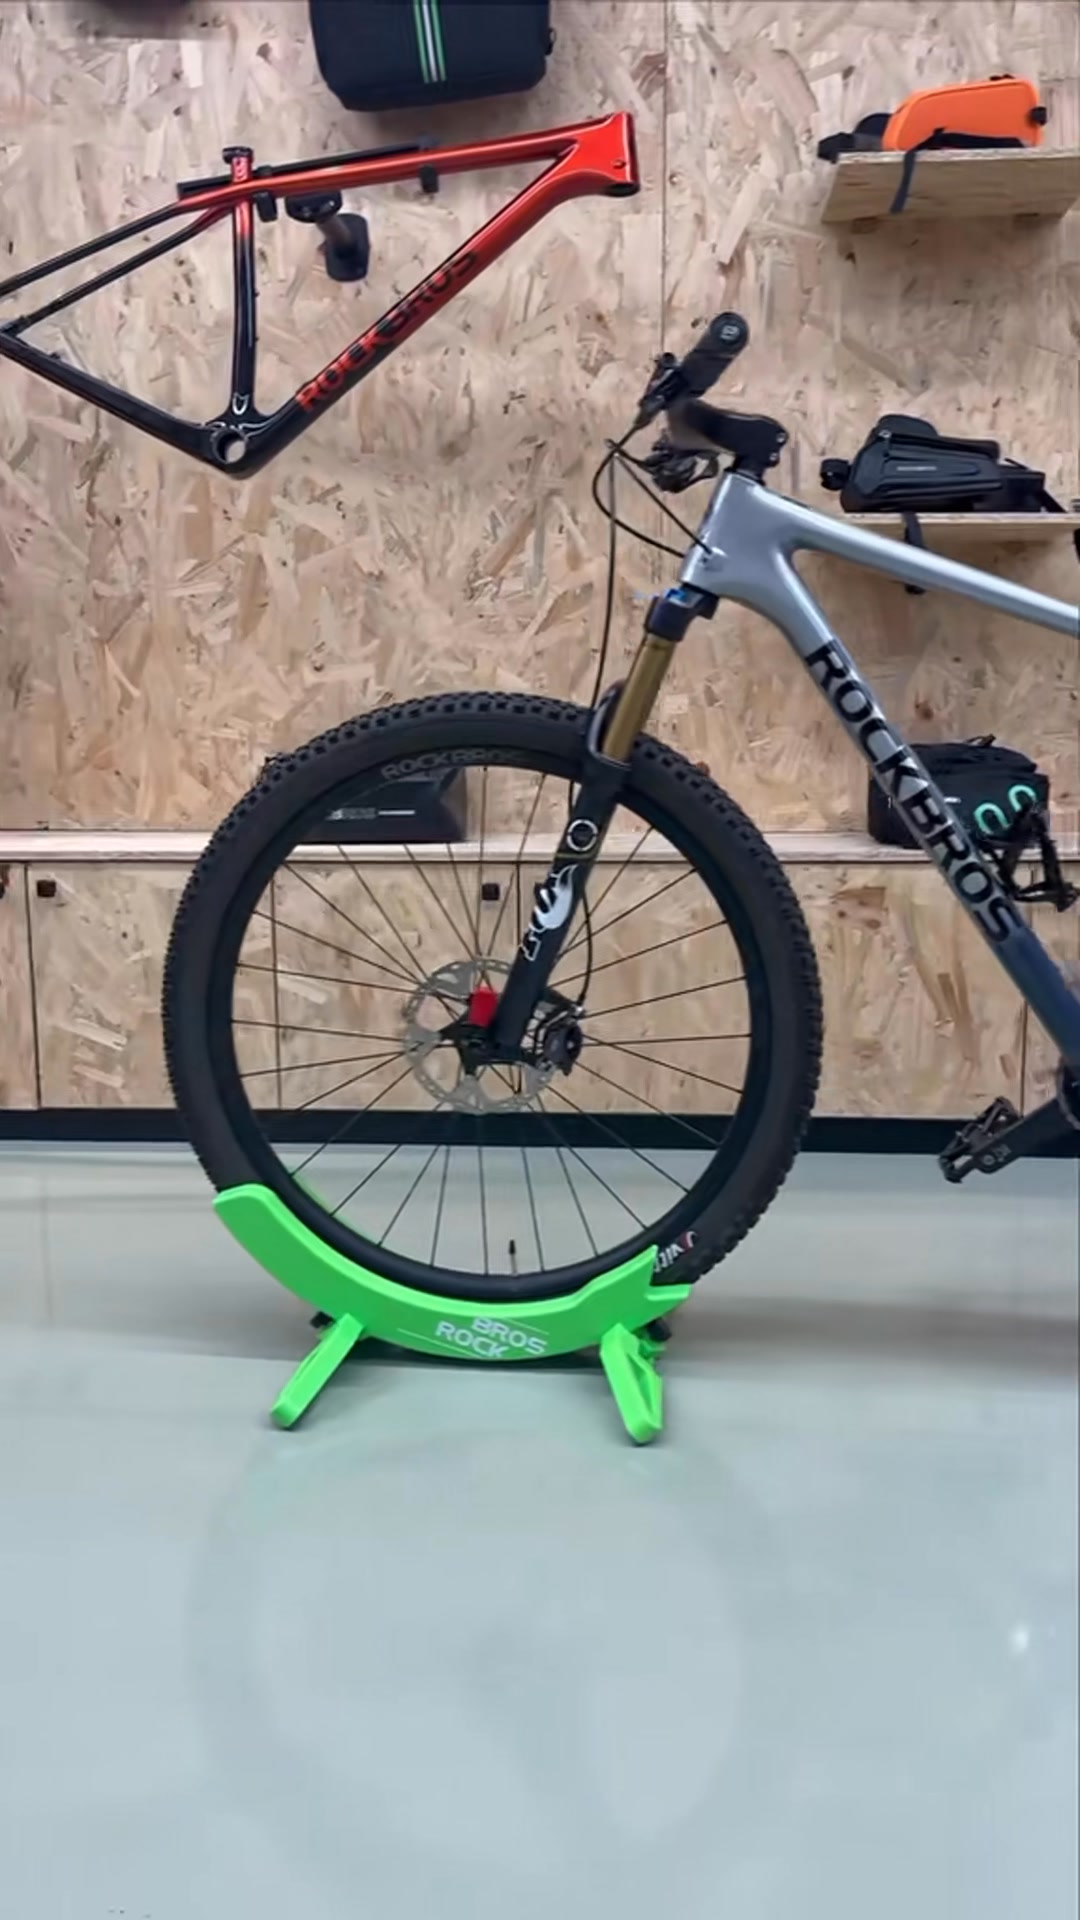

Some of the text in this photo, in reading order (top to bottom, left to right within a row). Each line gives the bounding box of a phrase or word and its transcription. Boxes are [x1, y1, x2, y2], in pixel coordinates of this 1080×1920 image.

[296, 251, 476, 412] ROCKBROS
[805, 638, 1022, 943] ROCKBROS
[434, 1320, 509, 1358] ROCK
[470, 1316, 547, 1355] BROS
